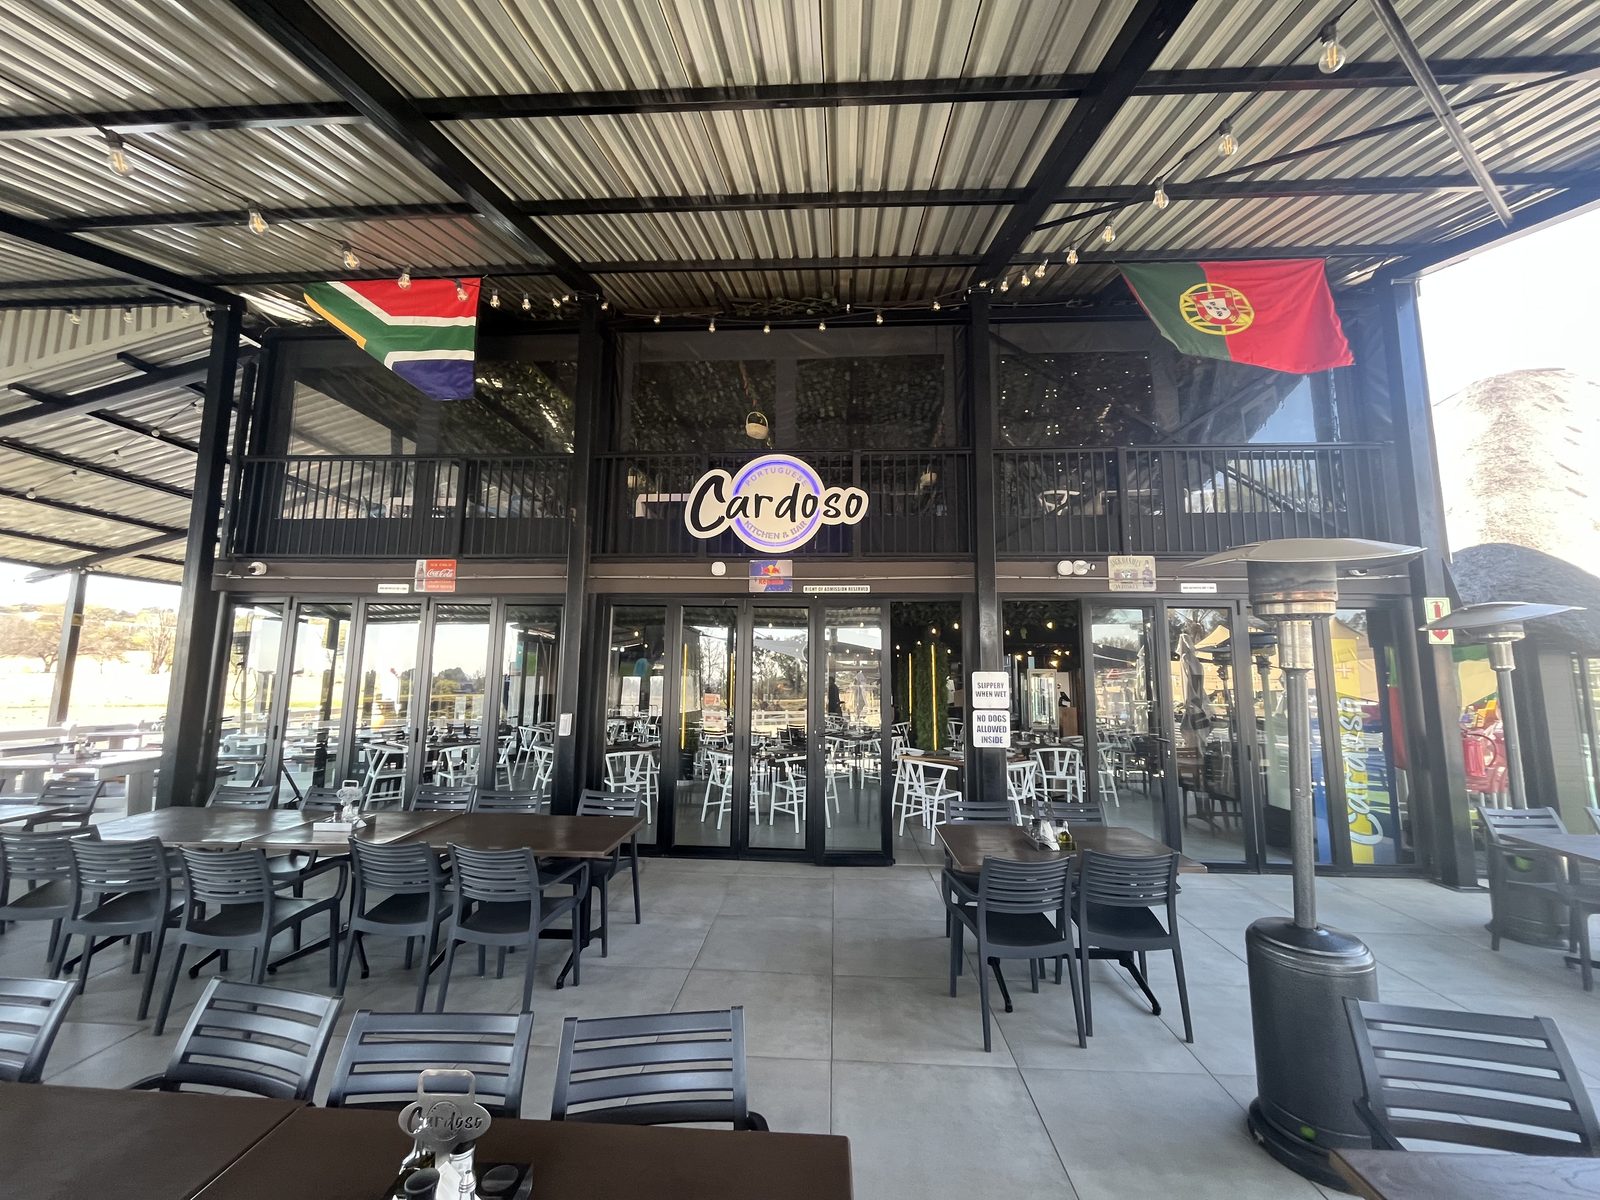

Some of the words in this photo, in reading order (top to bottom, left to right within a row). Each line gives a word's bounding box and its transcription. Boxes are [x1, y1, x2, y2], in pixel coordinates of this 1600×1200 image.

[745, 467, 809, 487] PORTUGUESE
[690, 475, 863, 532] Cardoso
[744, 520, 780, 539] KITCHEN
[790, 520, 807, 535] BAR
[975, 690, 993, 698] WHEN
[994, 690, 1007, 698] WET
[976, 714, 986, 723] NO
[987, 714, 1007, 723] DOGS
[976, 725, 1007, 734] ALLOWED
[981, 736, 1004, 744] INSIDE
[406, 1106, 483, 1134] Cardoso
